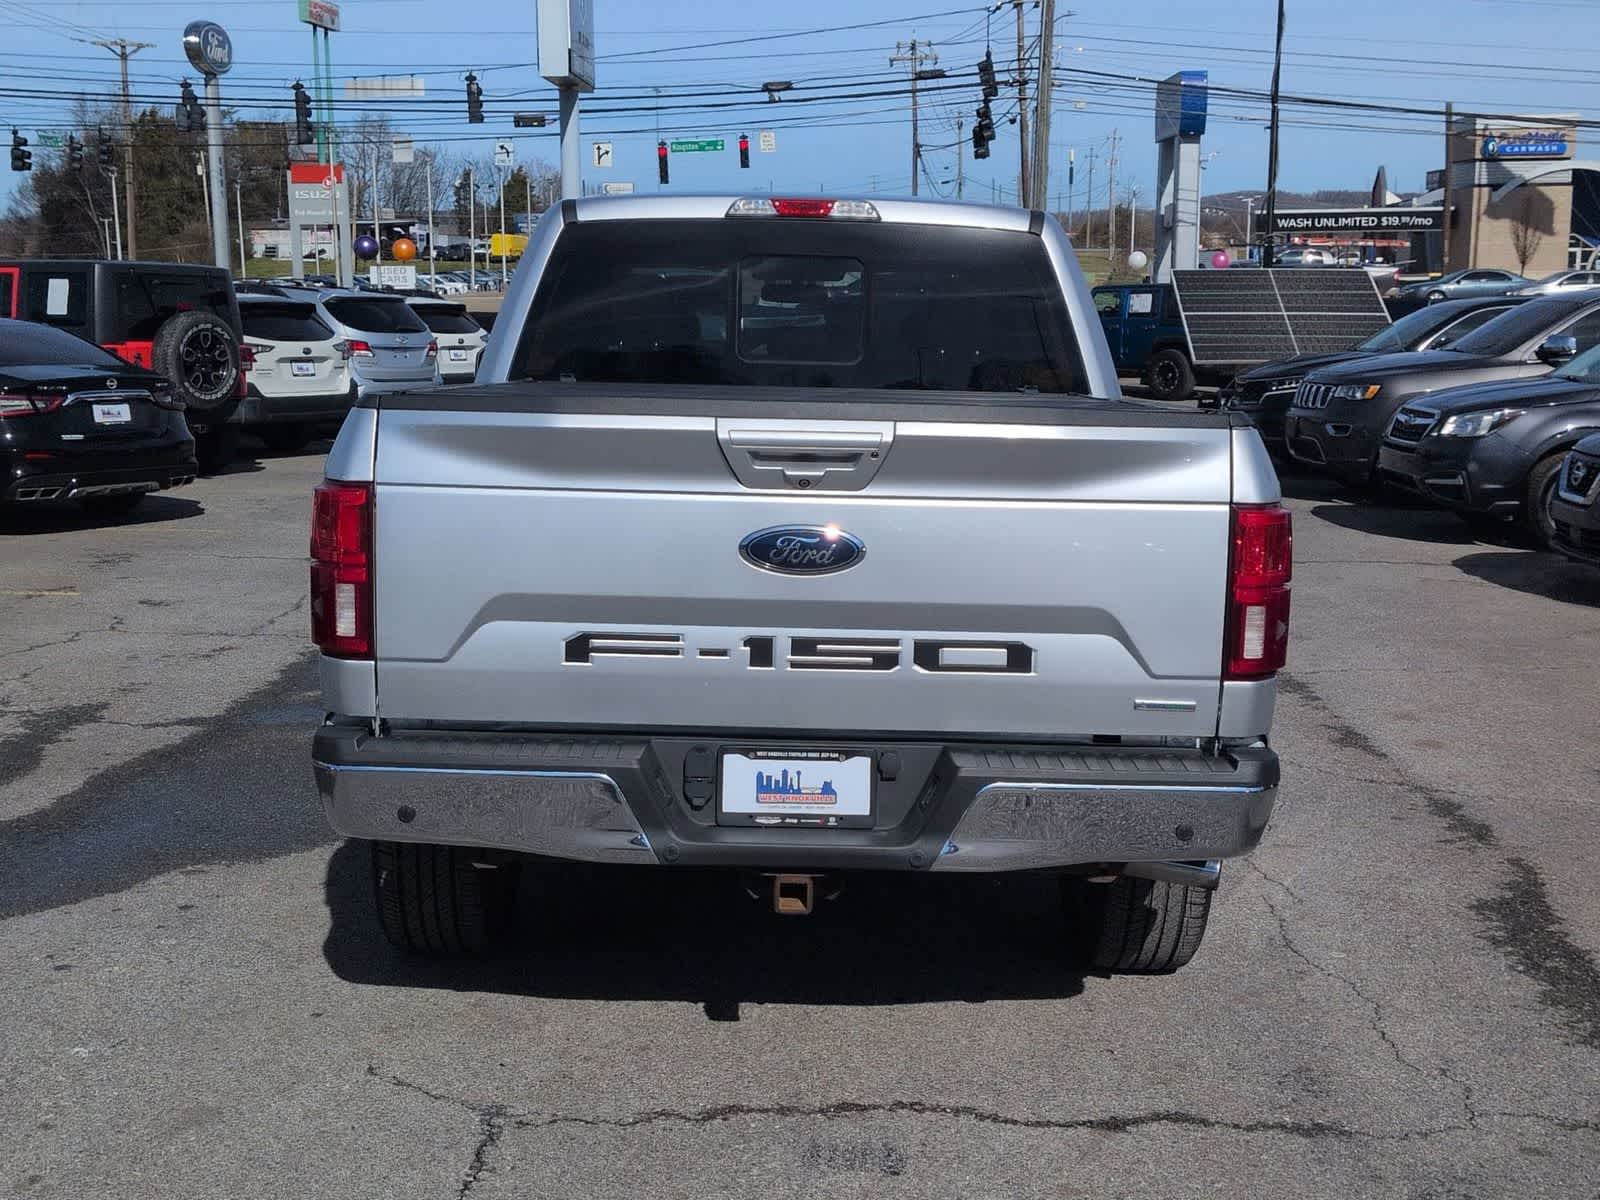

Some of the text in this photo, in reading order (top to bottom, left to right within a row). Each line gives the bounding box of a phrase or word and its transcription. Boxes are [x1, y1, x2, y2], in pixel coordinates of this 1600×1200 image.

[208, 31, 228, 64] Ford
[1277, 217, 1312, 228] WASH
[1315, 216, 1378, 227] UNLIMITED
[769, 535, 837, 564] Ford
[561, 631, 1037, 675] F-150
